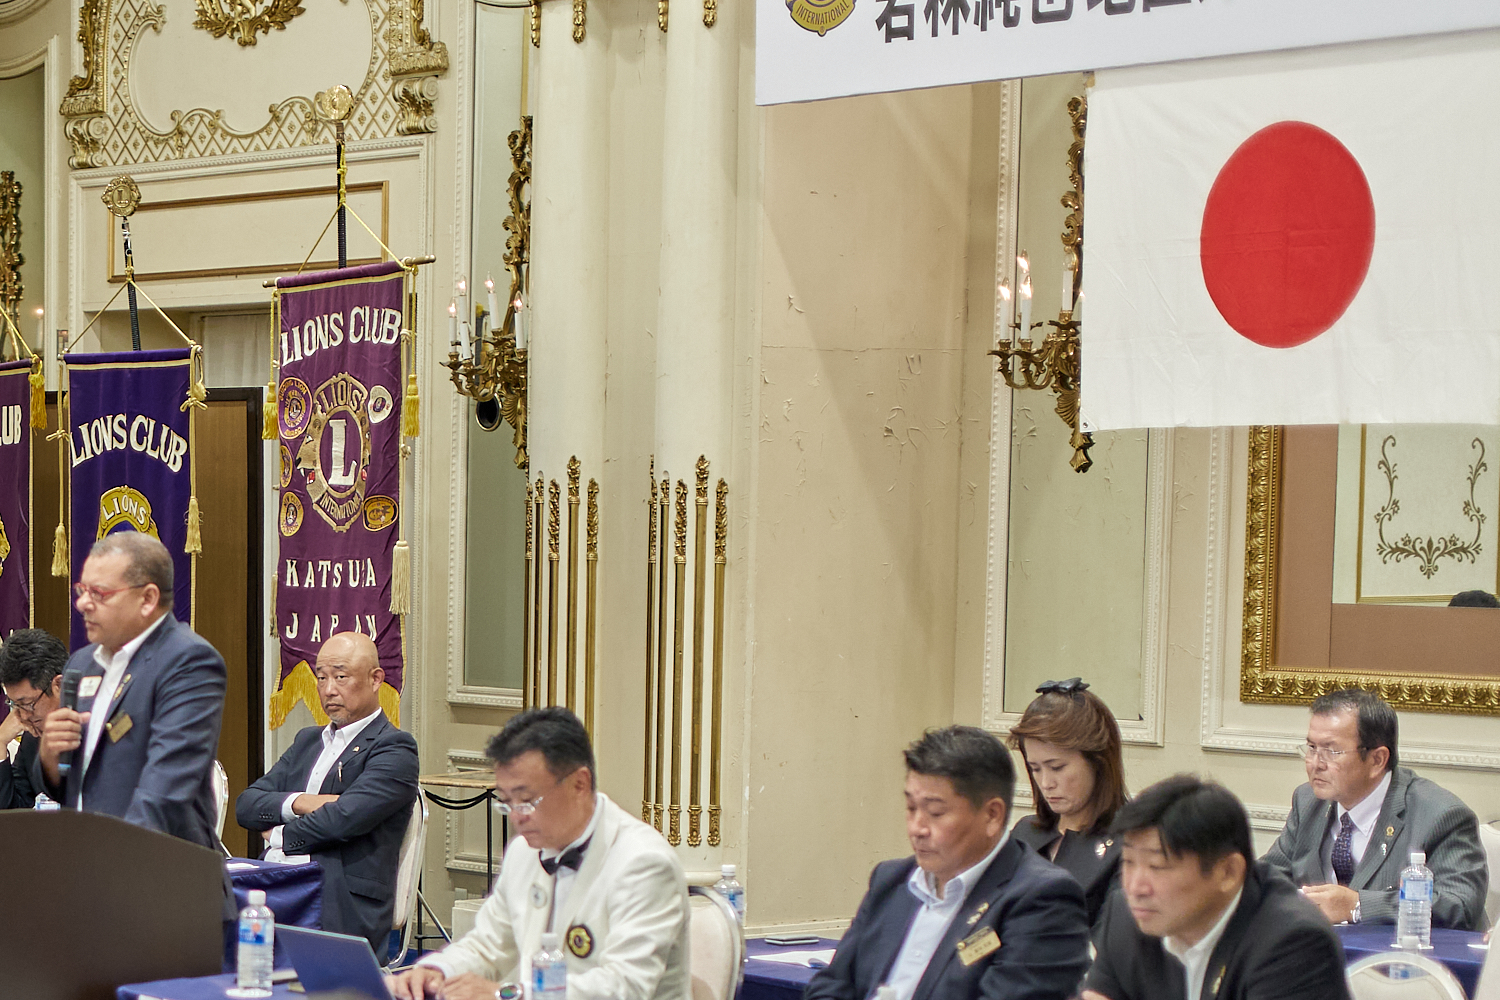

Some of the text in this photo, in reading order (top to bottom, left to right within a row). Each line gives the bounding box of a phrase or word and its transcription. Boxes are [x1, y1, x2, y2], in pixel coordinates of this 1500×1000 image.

[796, 0, 850, 25] INTERNATIONAL
[280, 305, 402, 367] LIONS CLUB
[70, 413, 188, 473] LIONS CLUB
[328, 419, 358, 486] L
[102, 494, 147, 525] LIONS
[285, 557, 377, 588] KATSUA
